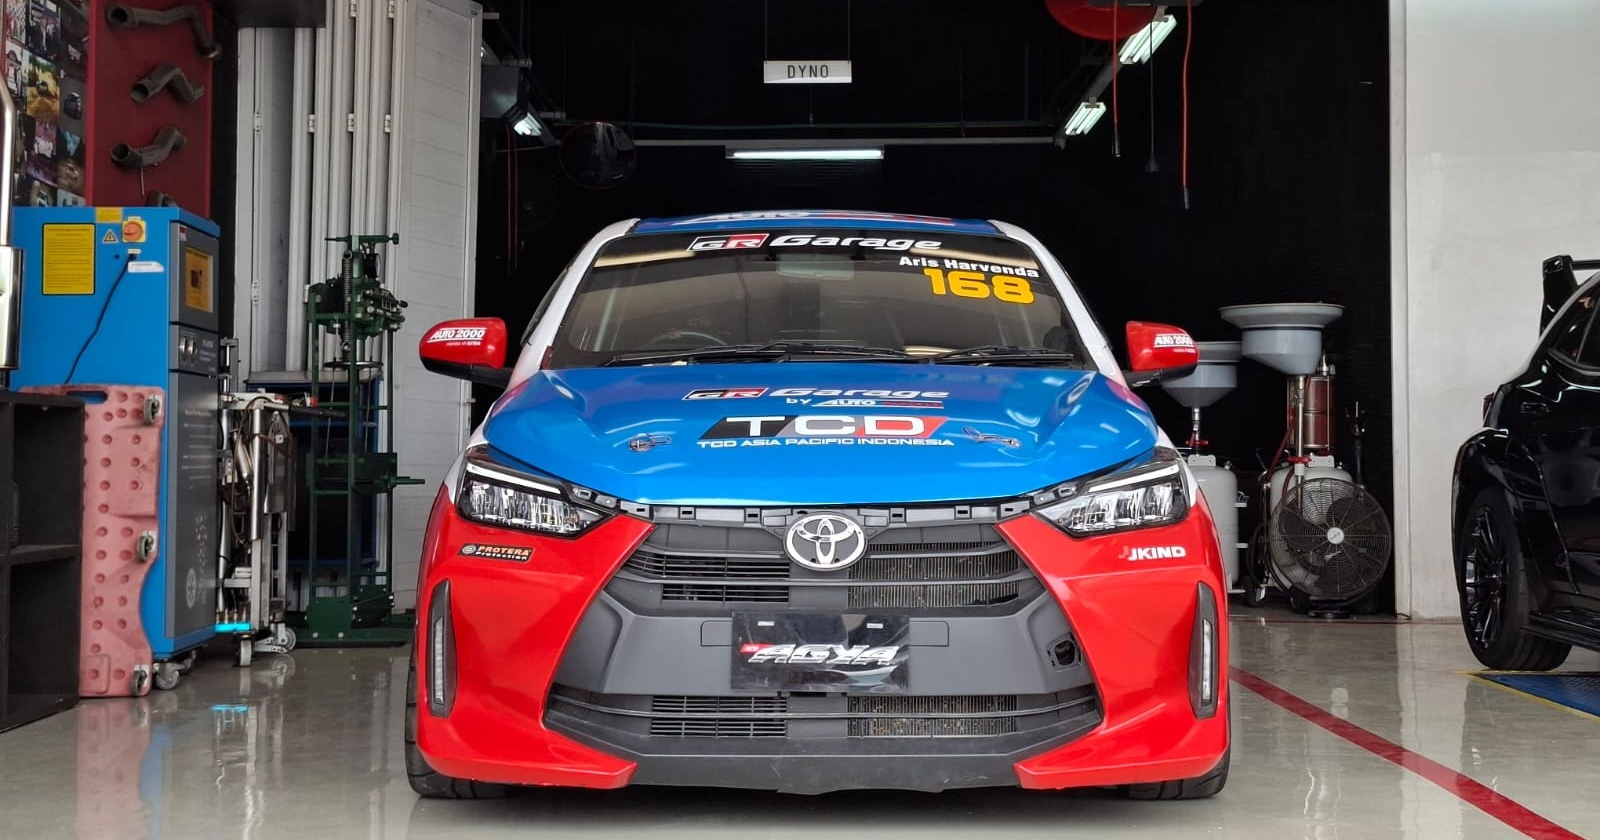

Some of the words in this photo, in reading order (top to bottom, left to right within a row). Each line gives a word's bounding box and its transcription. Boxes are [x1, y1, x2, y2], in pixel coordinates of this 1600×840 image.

[787, 64, 829, 79] DYNO
[690, 237, 766, 250] GR
[769, 234, 942, 250] Garage
[899, 256, 939, 267] Aris
[944, 259, 1040, 278] Harvenda
[923, 267, 1035, 304] 168
[430, 330, 456, 340] AUTO
[455, 330, 486, 338] 2000
[687, 389, 766, 399] GR
[769, 387, 950, 399] Garage
[726, 415, 925, 437] TCD
[858, 438, 955, 446] INDONESIA
[478, 546, 529, 556] PROTERA
[1128, 546, 1186, 561] JKIND
[748, 643, 900, 665] AGYA
